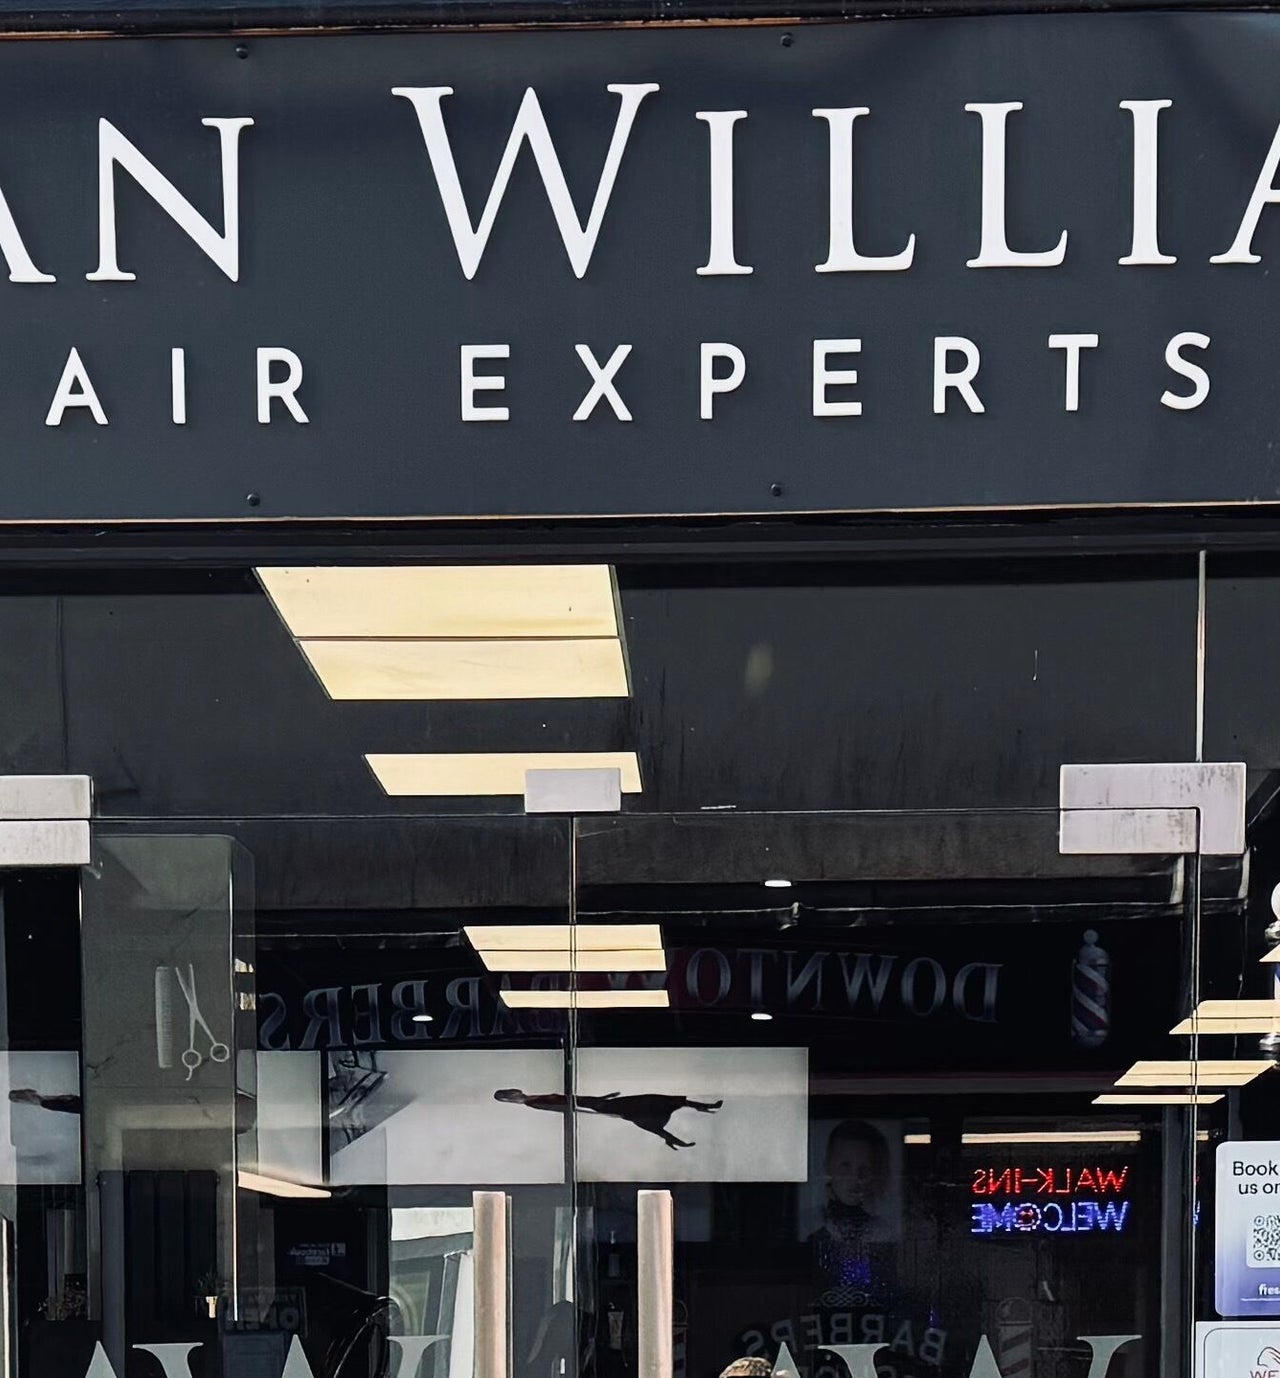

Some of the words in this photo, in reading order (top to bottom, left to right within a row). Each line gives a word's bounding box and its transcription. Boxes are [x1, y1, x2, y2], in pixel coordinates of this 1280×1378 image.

[458, 331, 1213, 423] EXPERTS
[1233, 1160, 1279, 1176] Book
[1238, 1182, 1258, 1195] us
